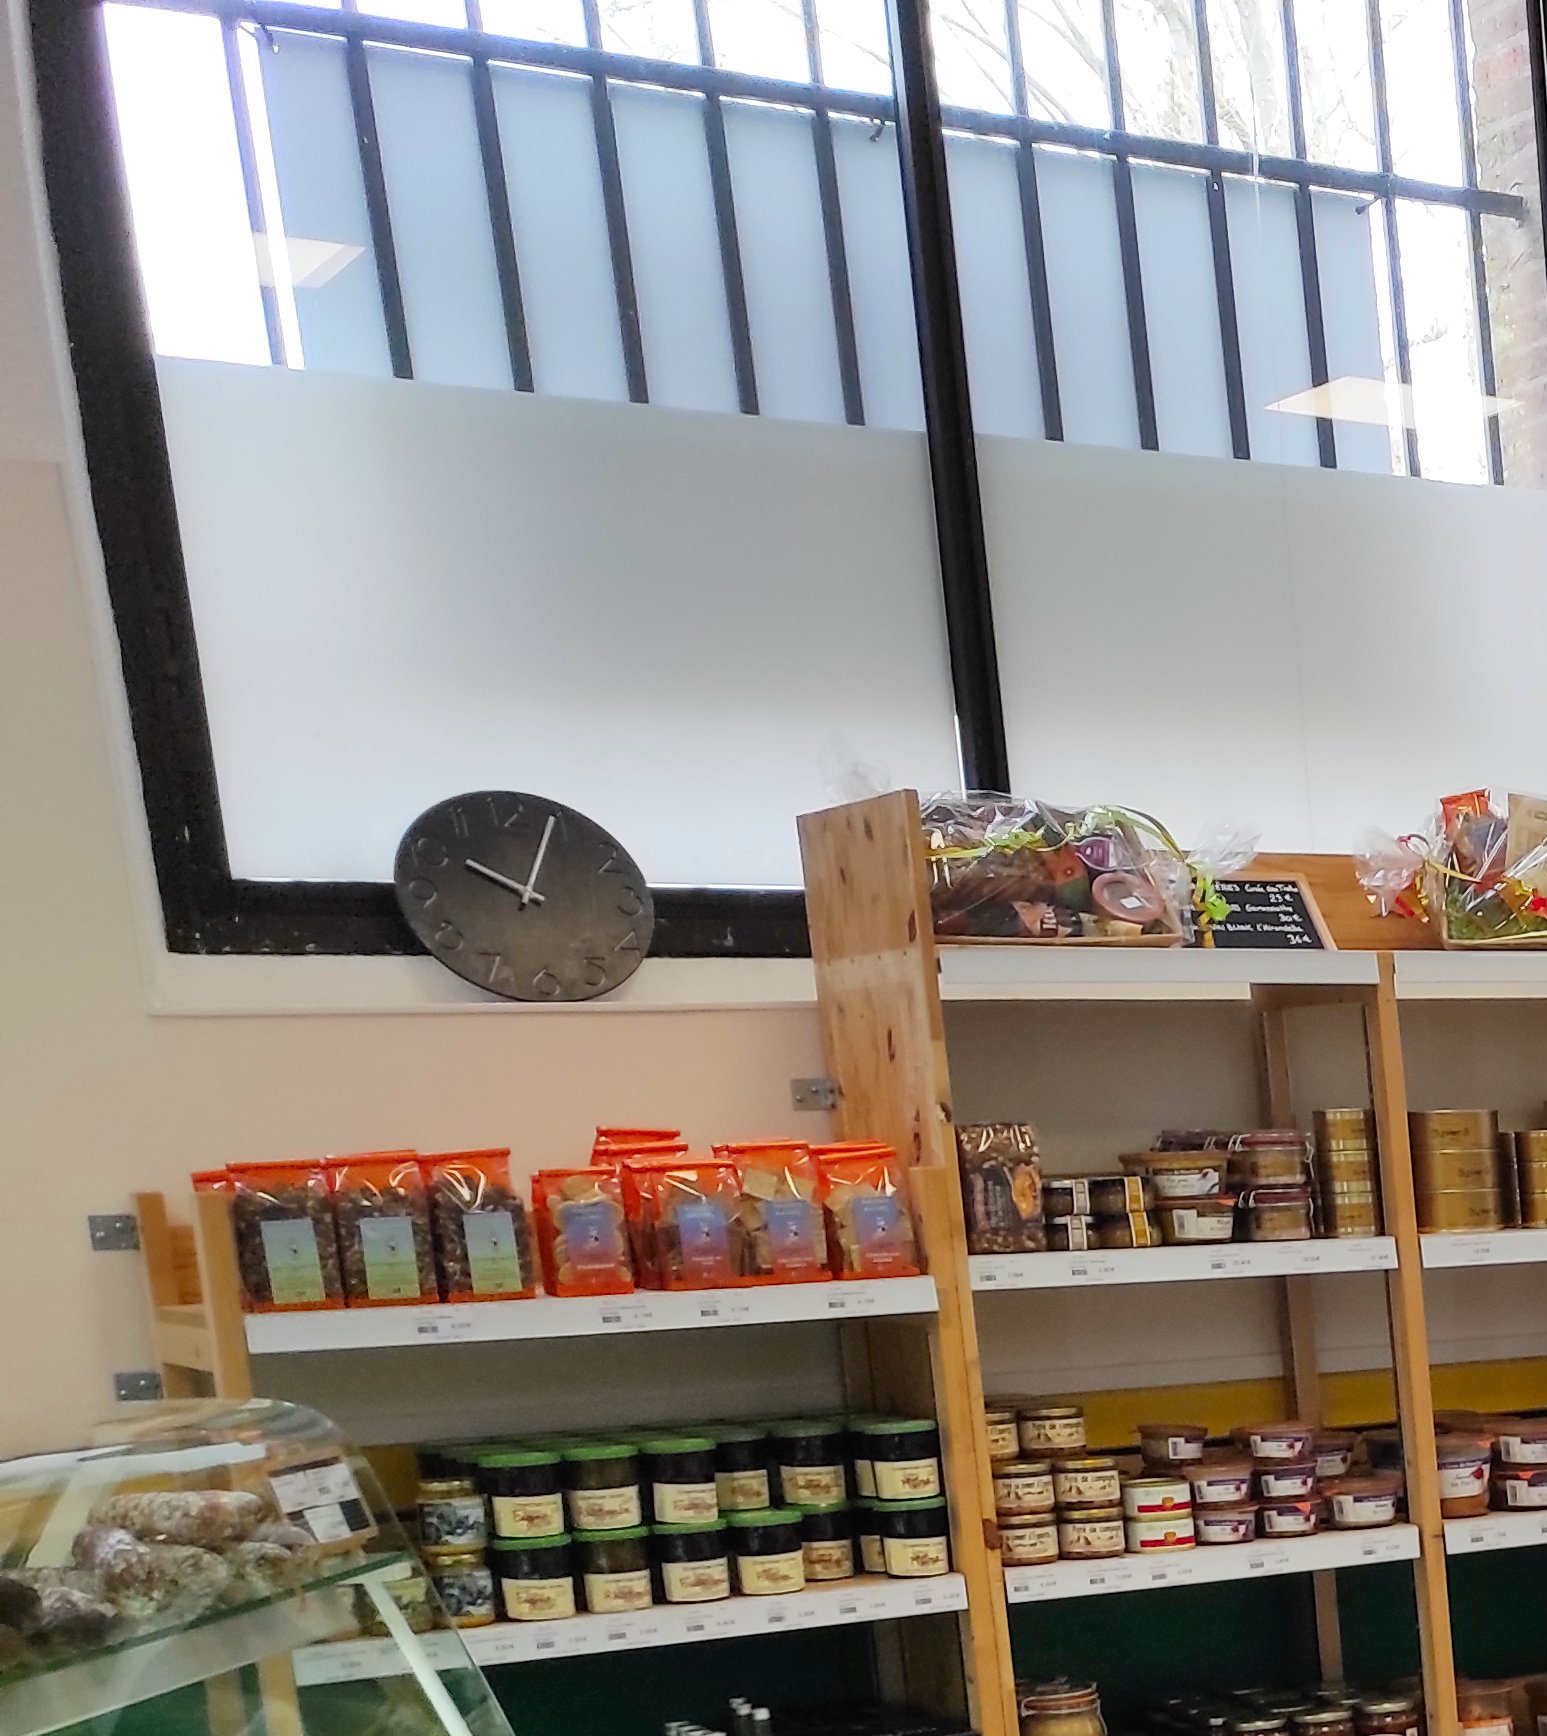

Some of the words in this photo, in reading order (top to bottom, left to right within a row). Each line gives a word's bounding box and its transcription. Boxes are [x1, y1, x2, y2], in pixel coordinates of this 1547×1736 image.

[487, 796, 531, 828] 12
[599, 841, 623, 874] 2
[479, 951, 503, 984] 7
[532, 967, 561, 997] 6
[582, 954, 608, 987] 5
